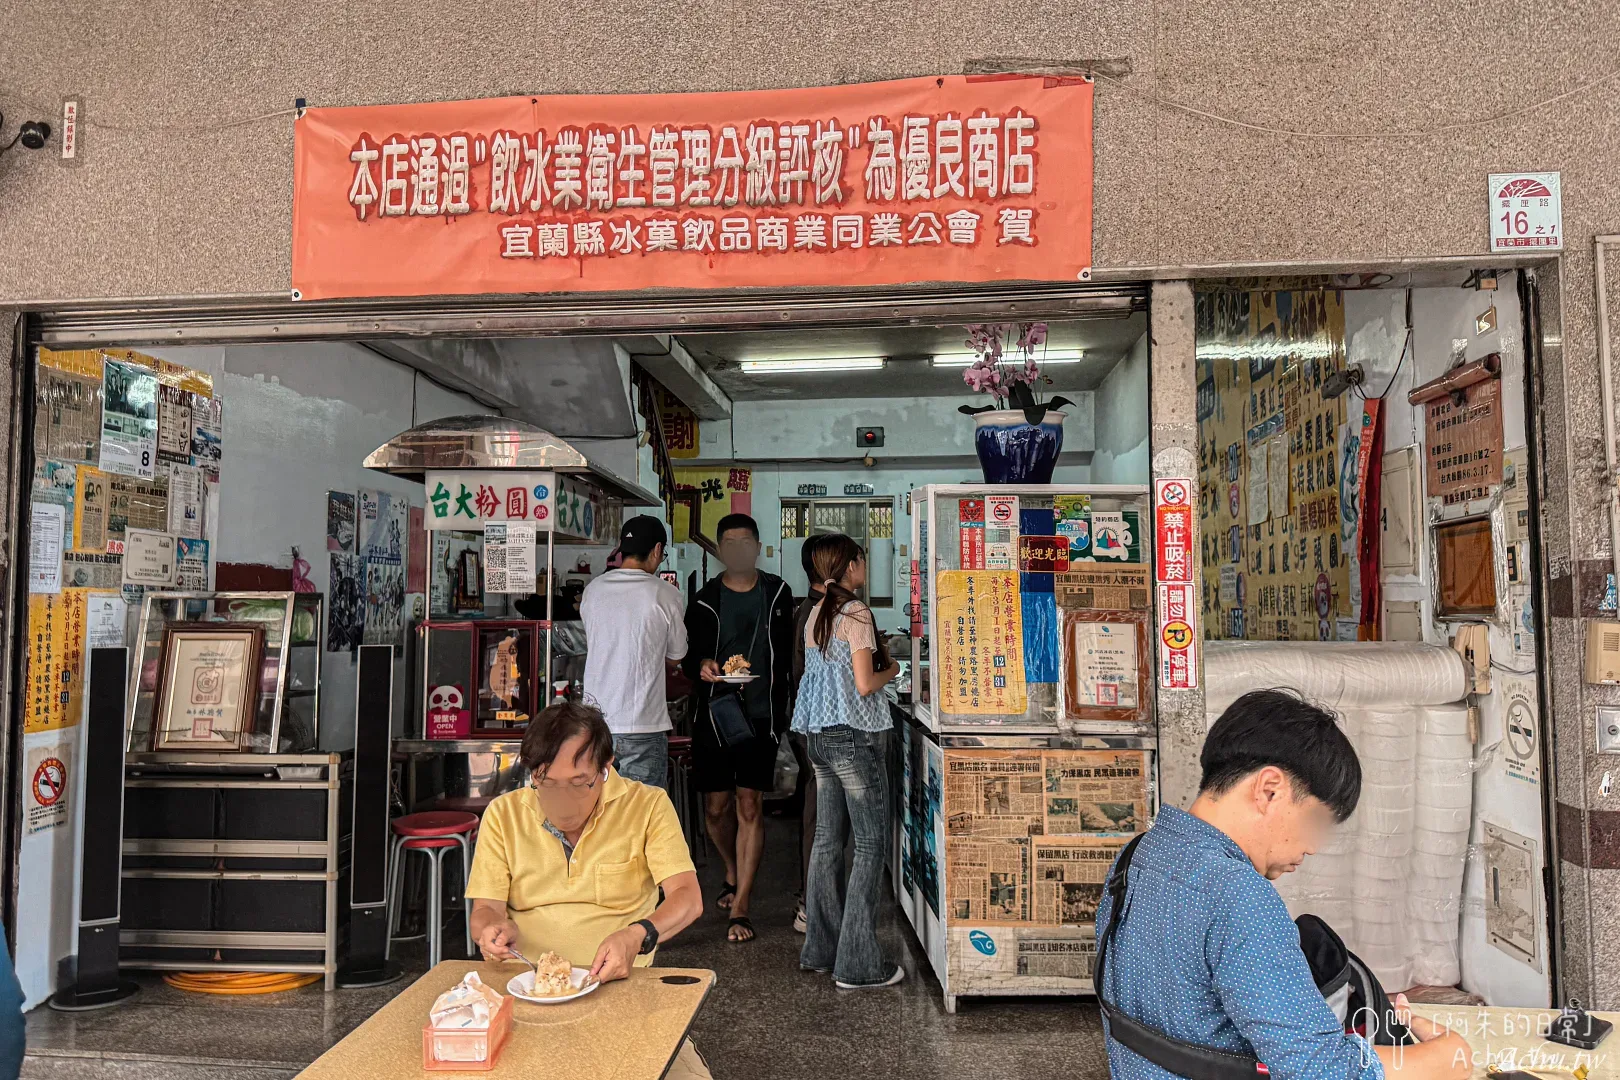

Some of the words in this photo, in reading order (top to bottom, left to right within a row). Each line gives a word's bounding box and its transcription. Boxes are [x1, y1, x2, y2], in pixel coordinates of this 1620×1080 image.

[502, 208, 980, 258] 宜蘭縣冰菓飲品商業同業公會
[999, 208, 1034, 245] 賀
[1501, 211, 1529, 235] 16
[141, 450, 150, 467] 8
[430, 481, 527, 519] 台大粉圓
[1020, 547, 1068, 562] 歡迎光臨
[1164, 512, 1185, 580] 禁止吸菸
[433, 714, 457, 723] 營業中
